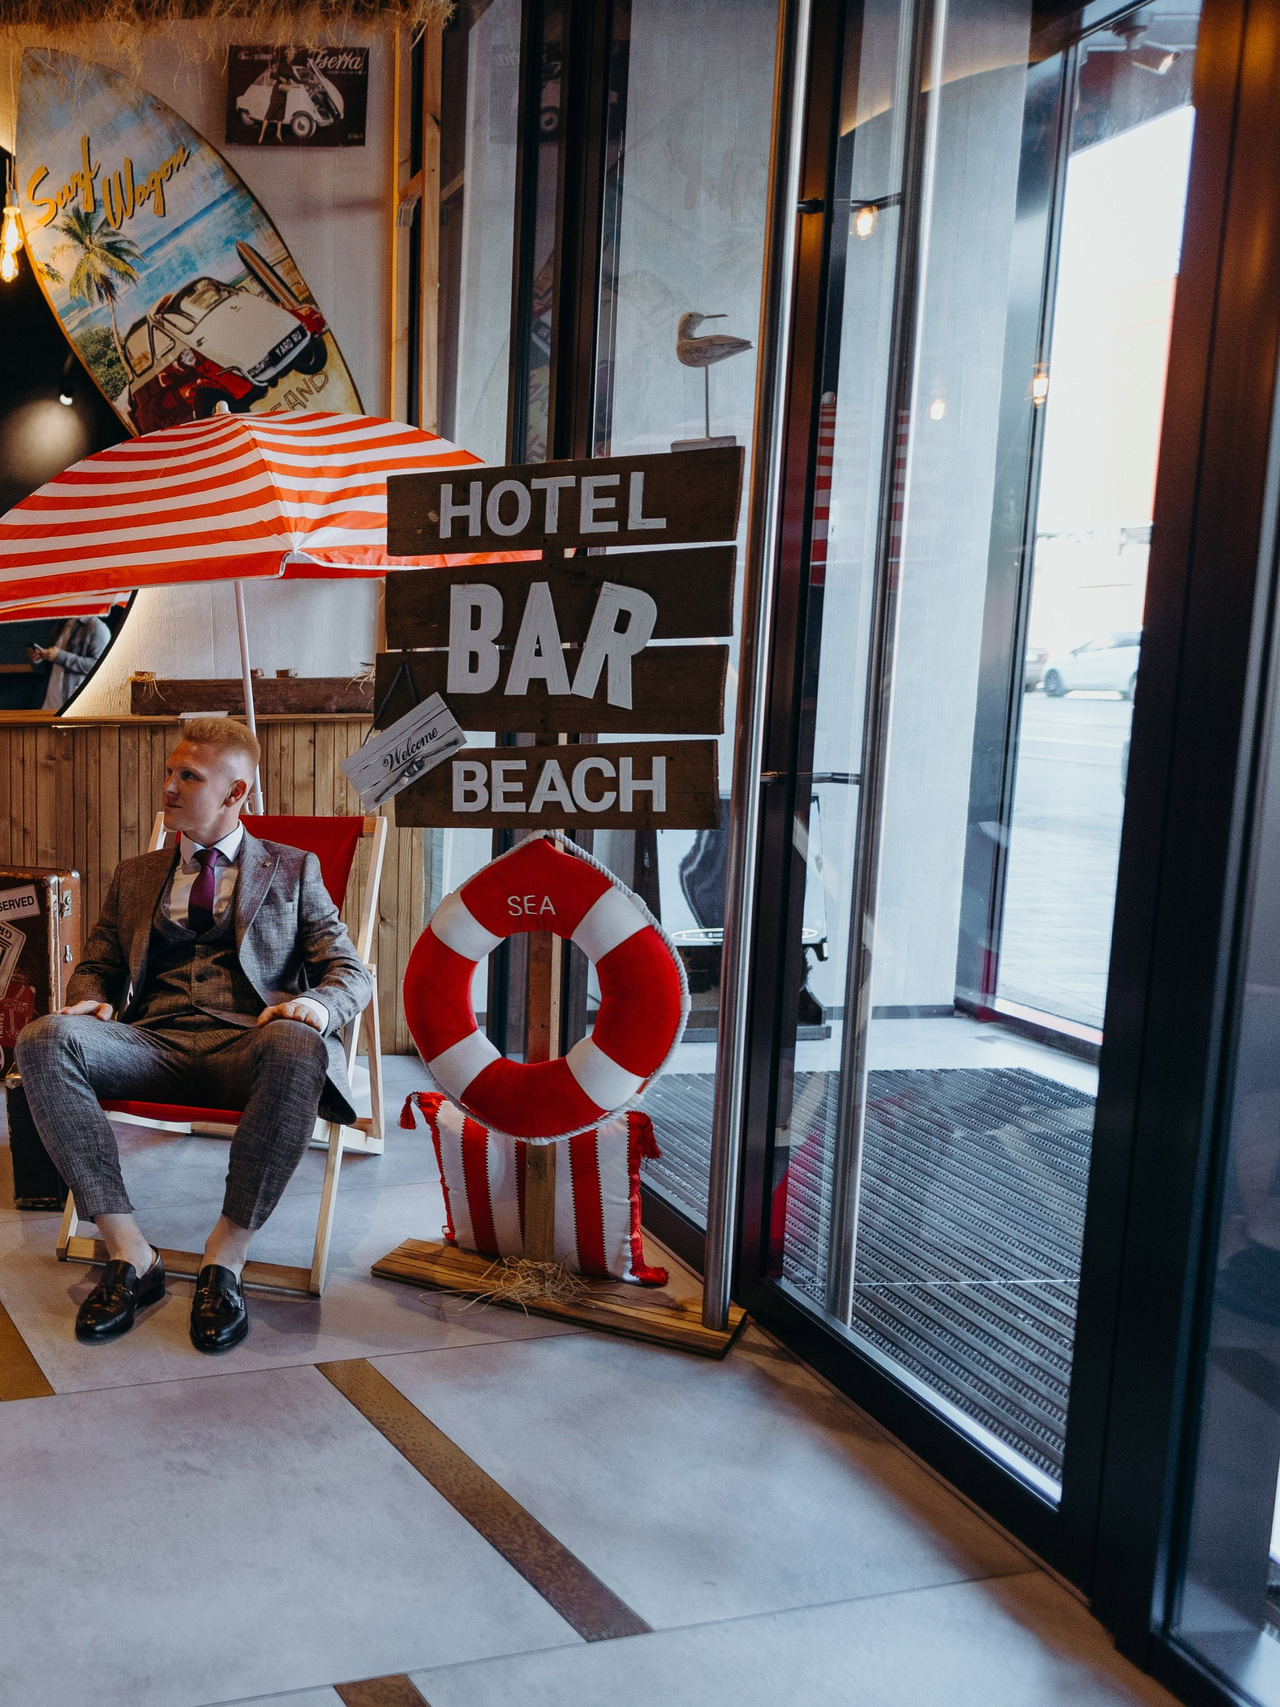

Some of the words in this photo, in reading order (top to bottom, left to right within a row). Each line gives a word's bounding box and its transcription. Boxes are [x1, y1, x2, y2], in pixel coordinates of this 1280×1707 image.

[27, 134, 101, 227] Surf
[102, 146, 191, 230] Wagon
[270, 370, 329, 412] AND
[439, 472, 666, 538] HOTEL
[446, 581, 657, 710] BAR
[382, 727, 438, 771] Welcome
[452, 756, 666, 813] BEACH
[507, 895, 556, 916] SEA
